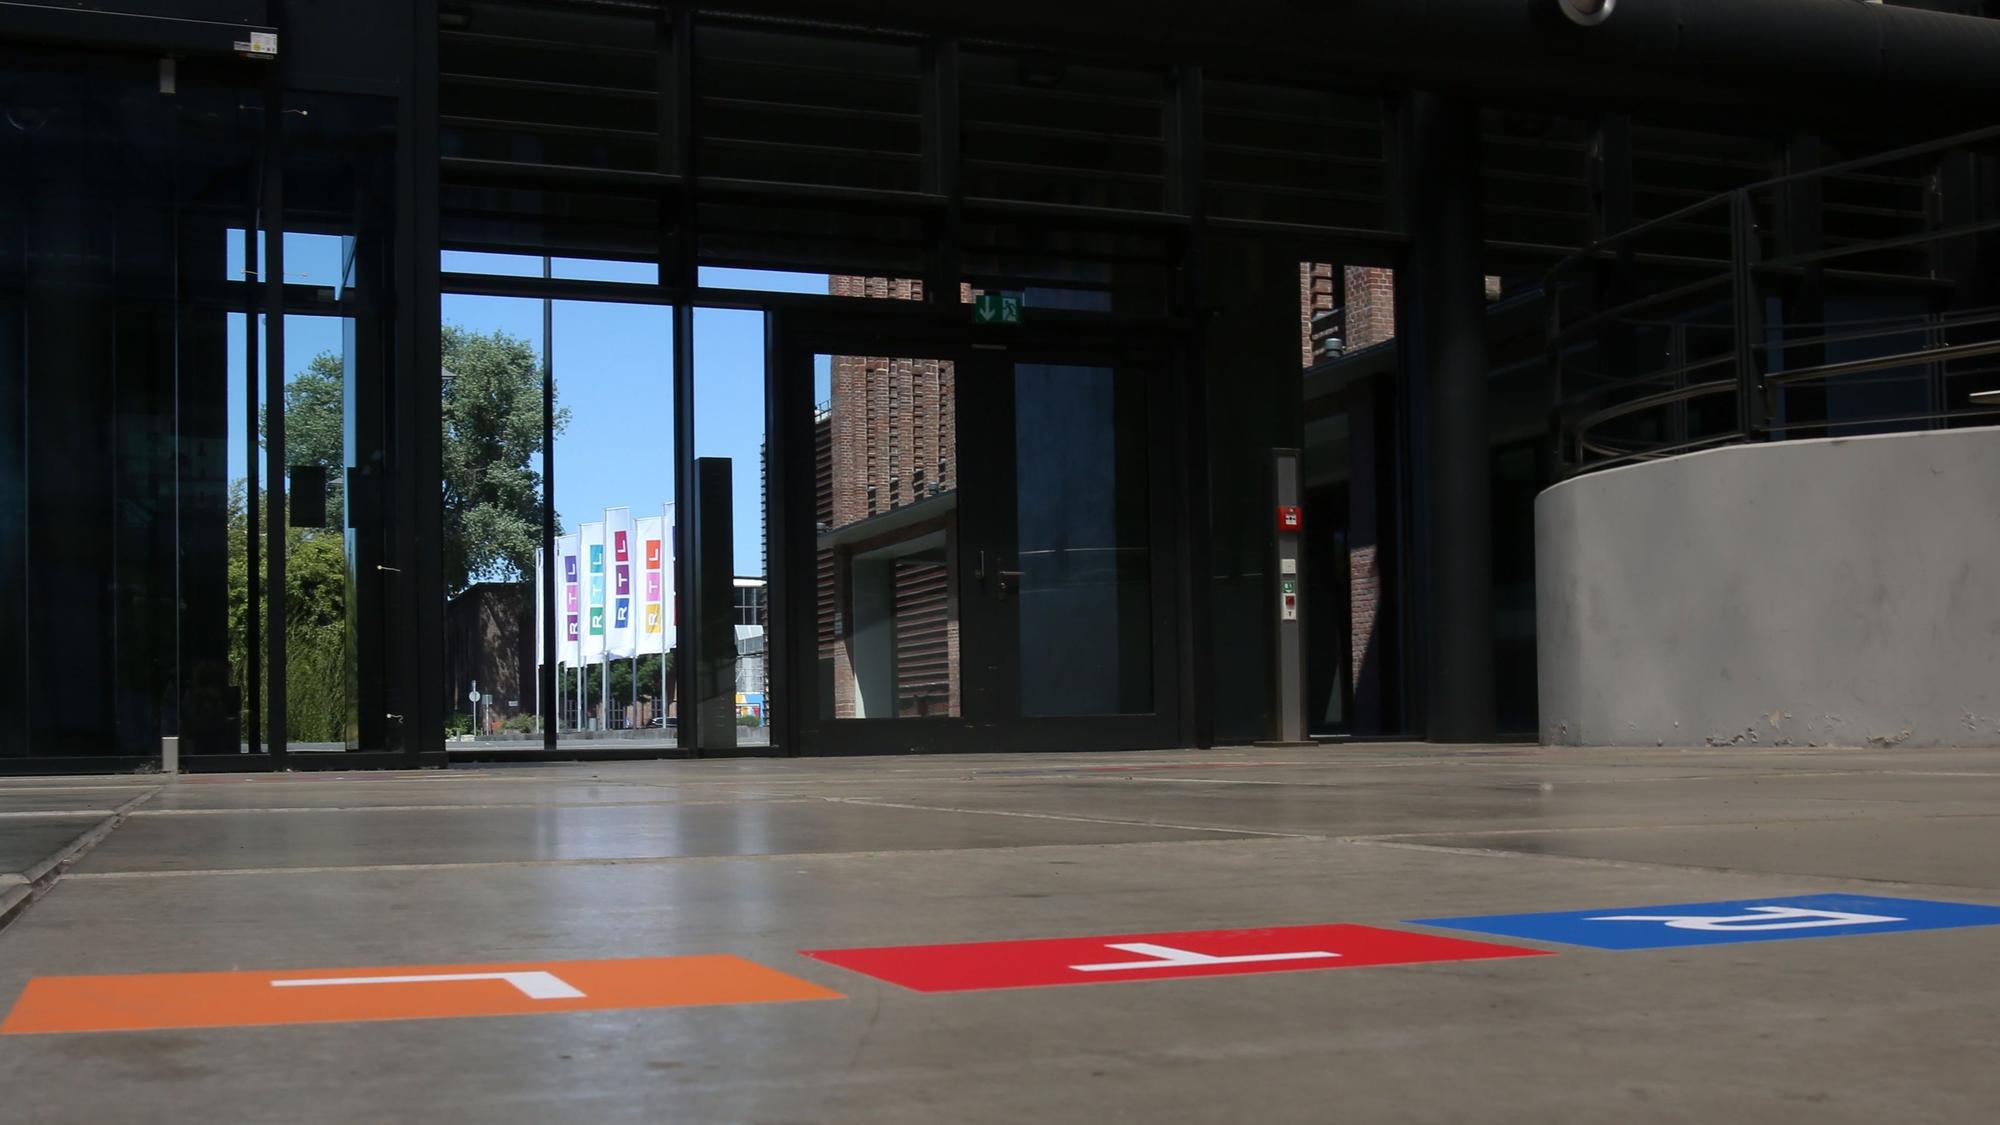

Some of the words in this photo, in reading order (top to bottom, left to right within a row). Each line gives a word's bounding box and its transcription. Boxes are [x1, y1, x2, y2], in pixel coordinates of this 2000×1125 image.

[566, 561, 578, 636] RTL
[592, 551, 603, 629] RTL
[617, 538, 628, 621] RTL
[648, 546, 659, 626] RTL
